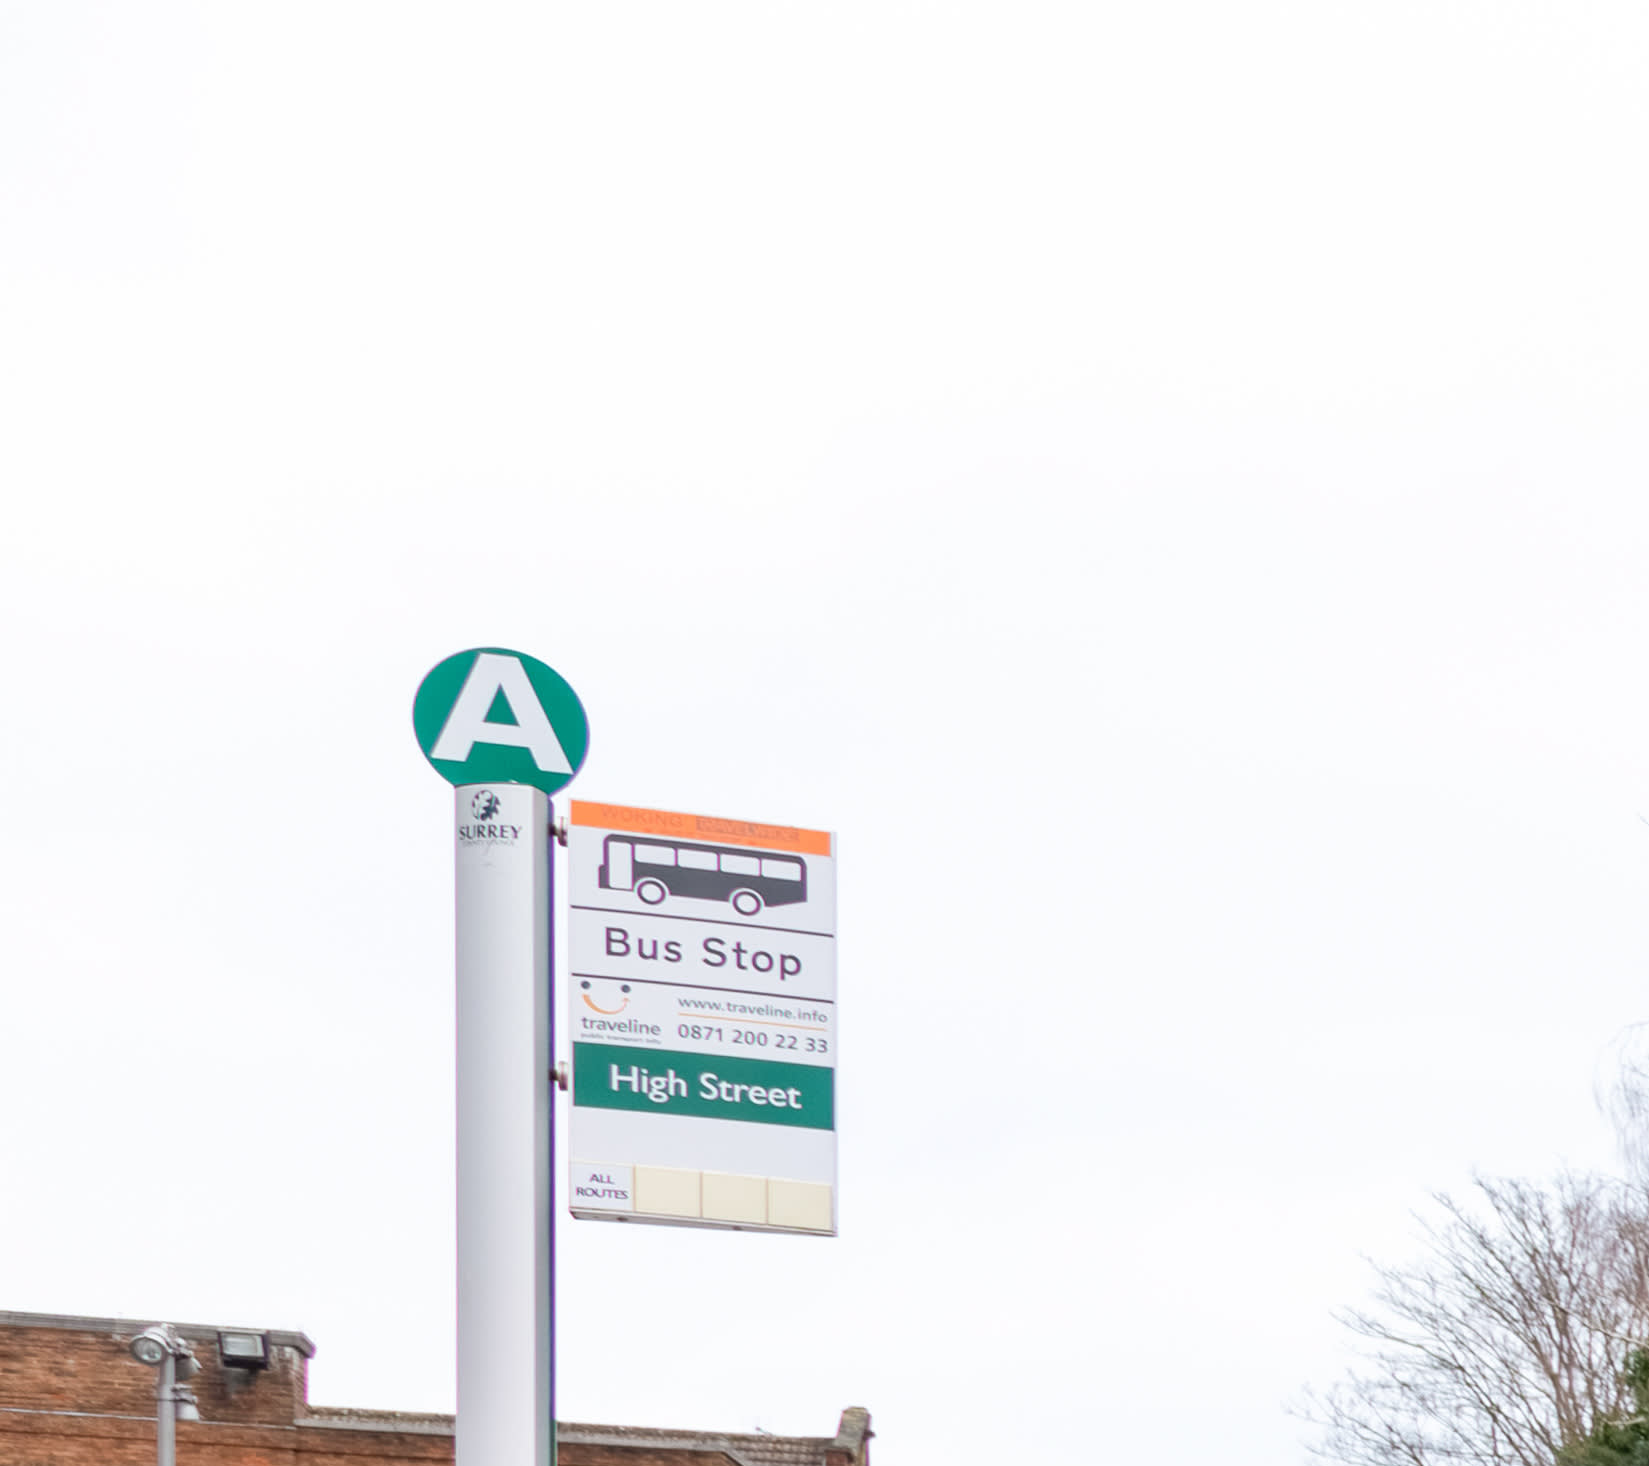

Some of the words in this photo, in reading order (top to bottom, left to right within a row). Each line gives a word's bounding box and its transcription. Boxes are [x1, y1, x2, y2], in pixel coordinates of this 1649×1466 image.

[430, 652, 575, 776] A
[459, 825, 521, 840] SURREY
[605, 927, 683, 963] Bus
[702, 936, 802, 981] Stop
[678, 997, 829, 1023] www.traveline.info
[581, 1016, 661, 1036] traveline
[678, 1024, 723, 1042] 0871
[732, 1029, 768, 1046] 200
[776, 1034, 798, 1050] 22
[805, 1038, 828, 1053] 33
[608, 1063, 688, 1103] High
[698, 1072, 802, 1109] Street
[589, 1173, 615, 1184] ALL
[575, 1187, 629, 1200] ROUTES
